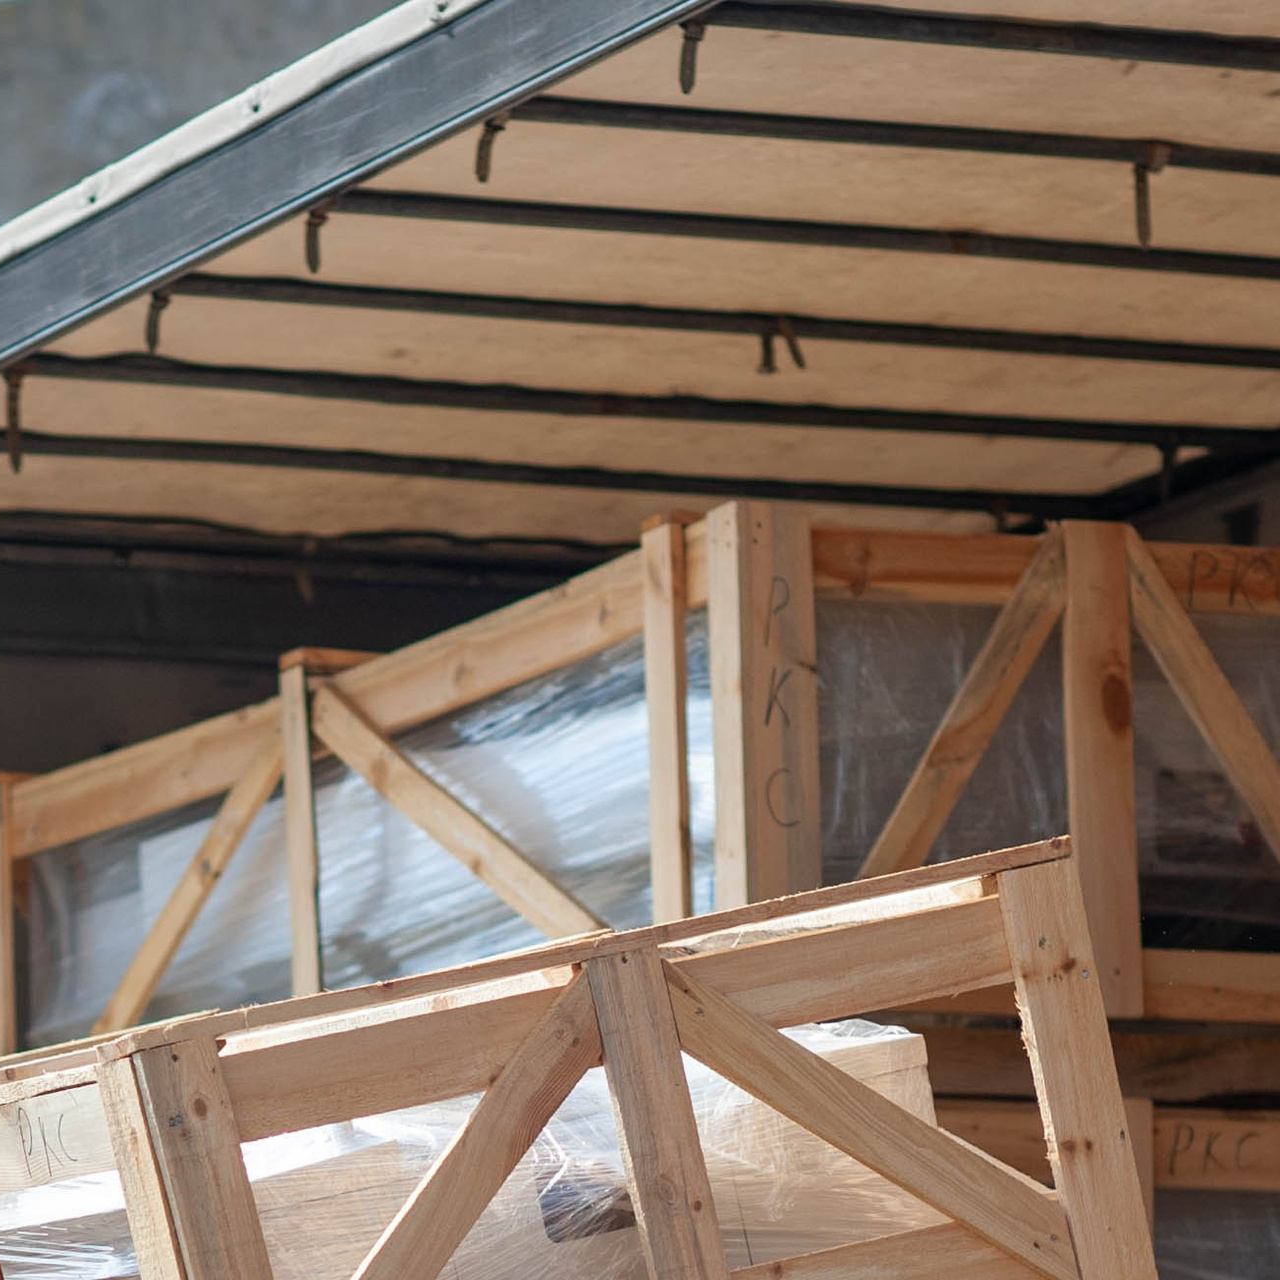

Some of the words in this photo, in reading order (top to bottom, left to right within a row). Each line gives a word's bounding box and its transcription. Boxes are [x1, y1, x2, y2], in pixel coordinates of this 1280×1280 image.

[1186, 549, 1280, 612] PK
[16, 1106, 79, 1179] PKC
[1168, 1121, 1261, 1177] PKC
